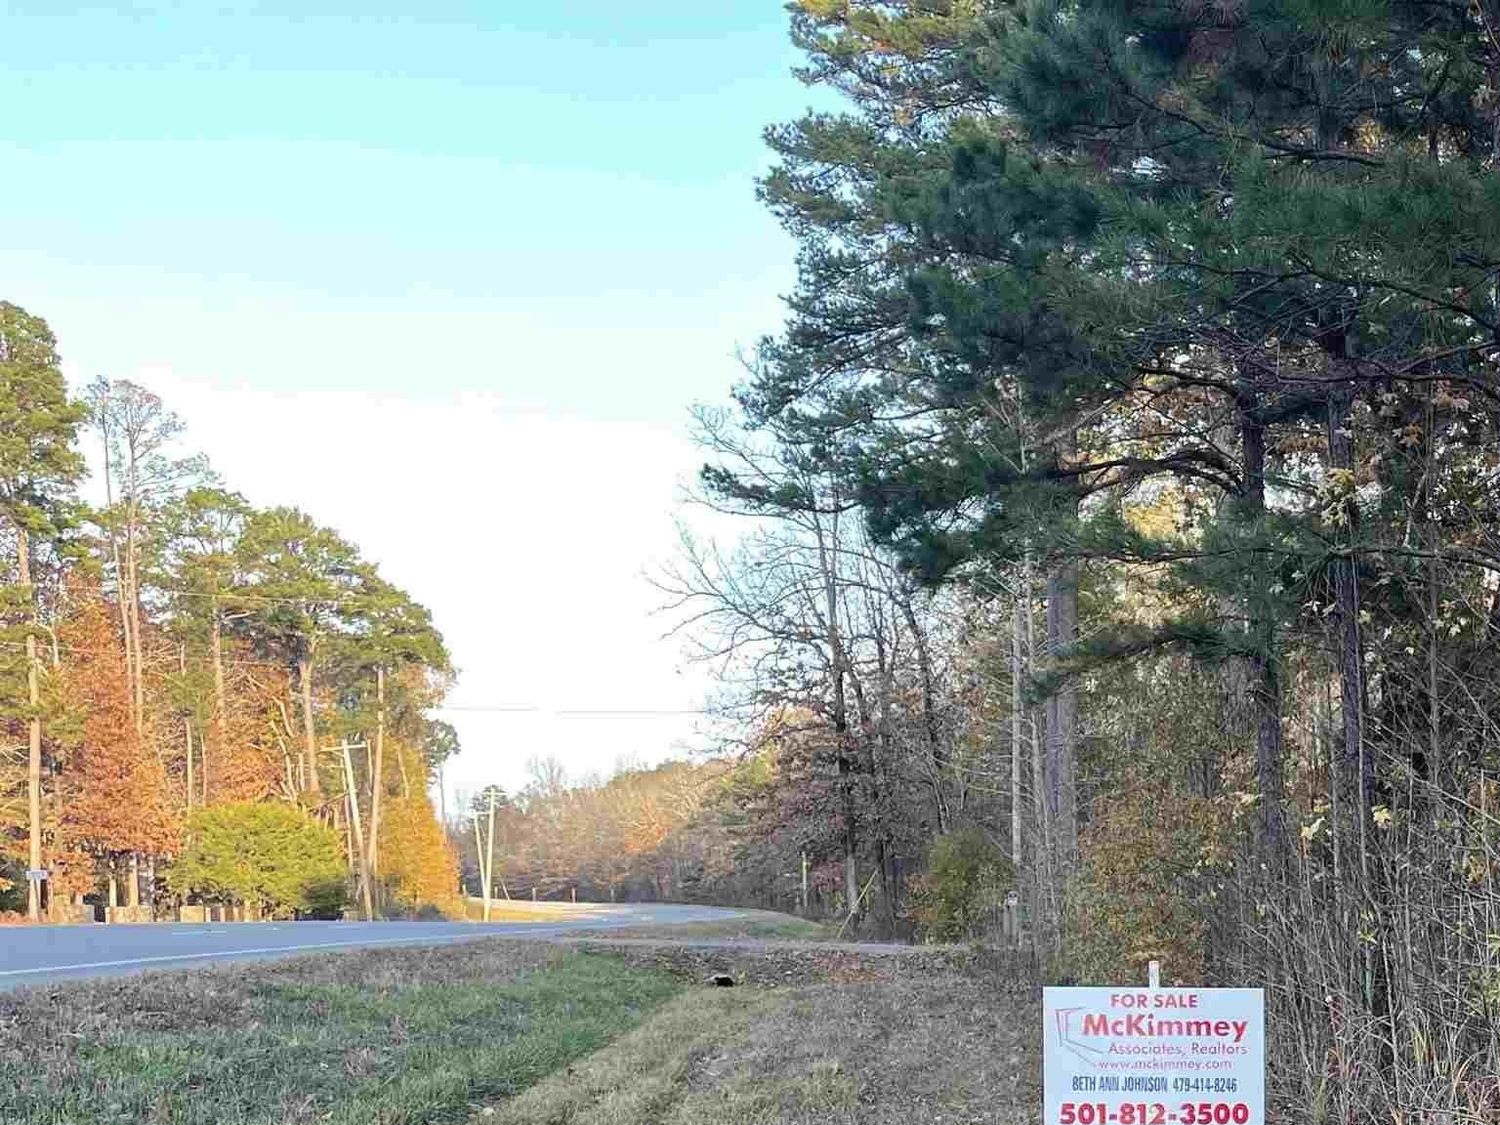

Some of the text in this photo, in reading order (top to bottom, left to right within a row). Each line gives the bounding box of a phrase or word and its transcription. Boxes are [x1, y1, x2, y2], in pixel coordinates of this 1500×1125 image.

[1111, 994, 1198, 1008] FOR SALE
[1083, 1013, 1248, 1042] McKimmey
[1109, 1042, 1248, 1056] Associates, Realtors
[1099, 1058, 1232, 1070] www.mckimmey.com
[1072, 1076, 1096, 1091] BETH
[1099, 1076, 1119, 1091] ANN
[1121, 1076, 1168, 1092] JOHNSON
[1059, 1103, 1249, 1125] 501-812-3500
